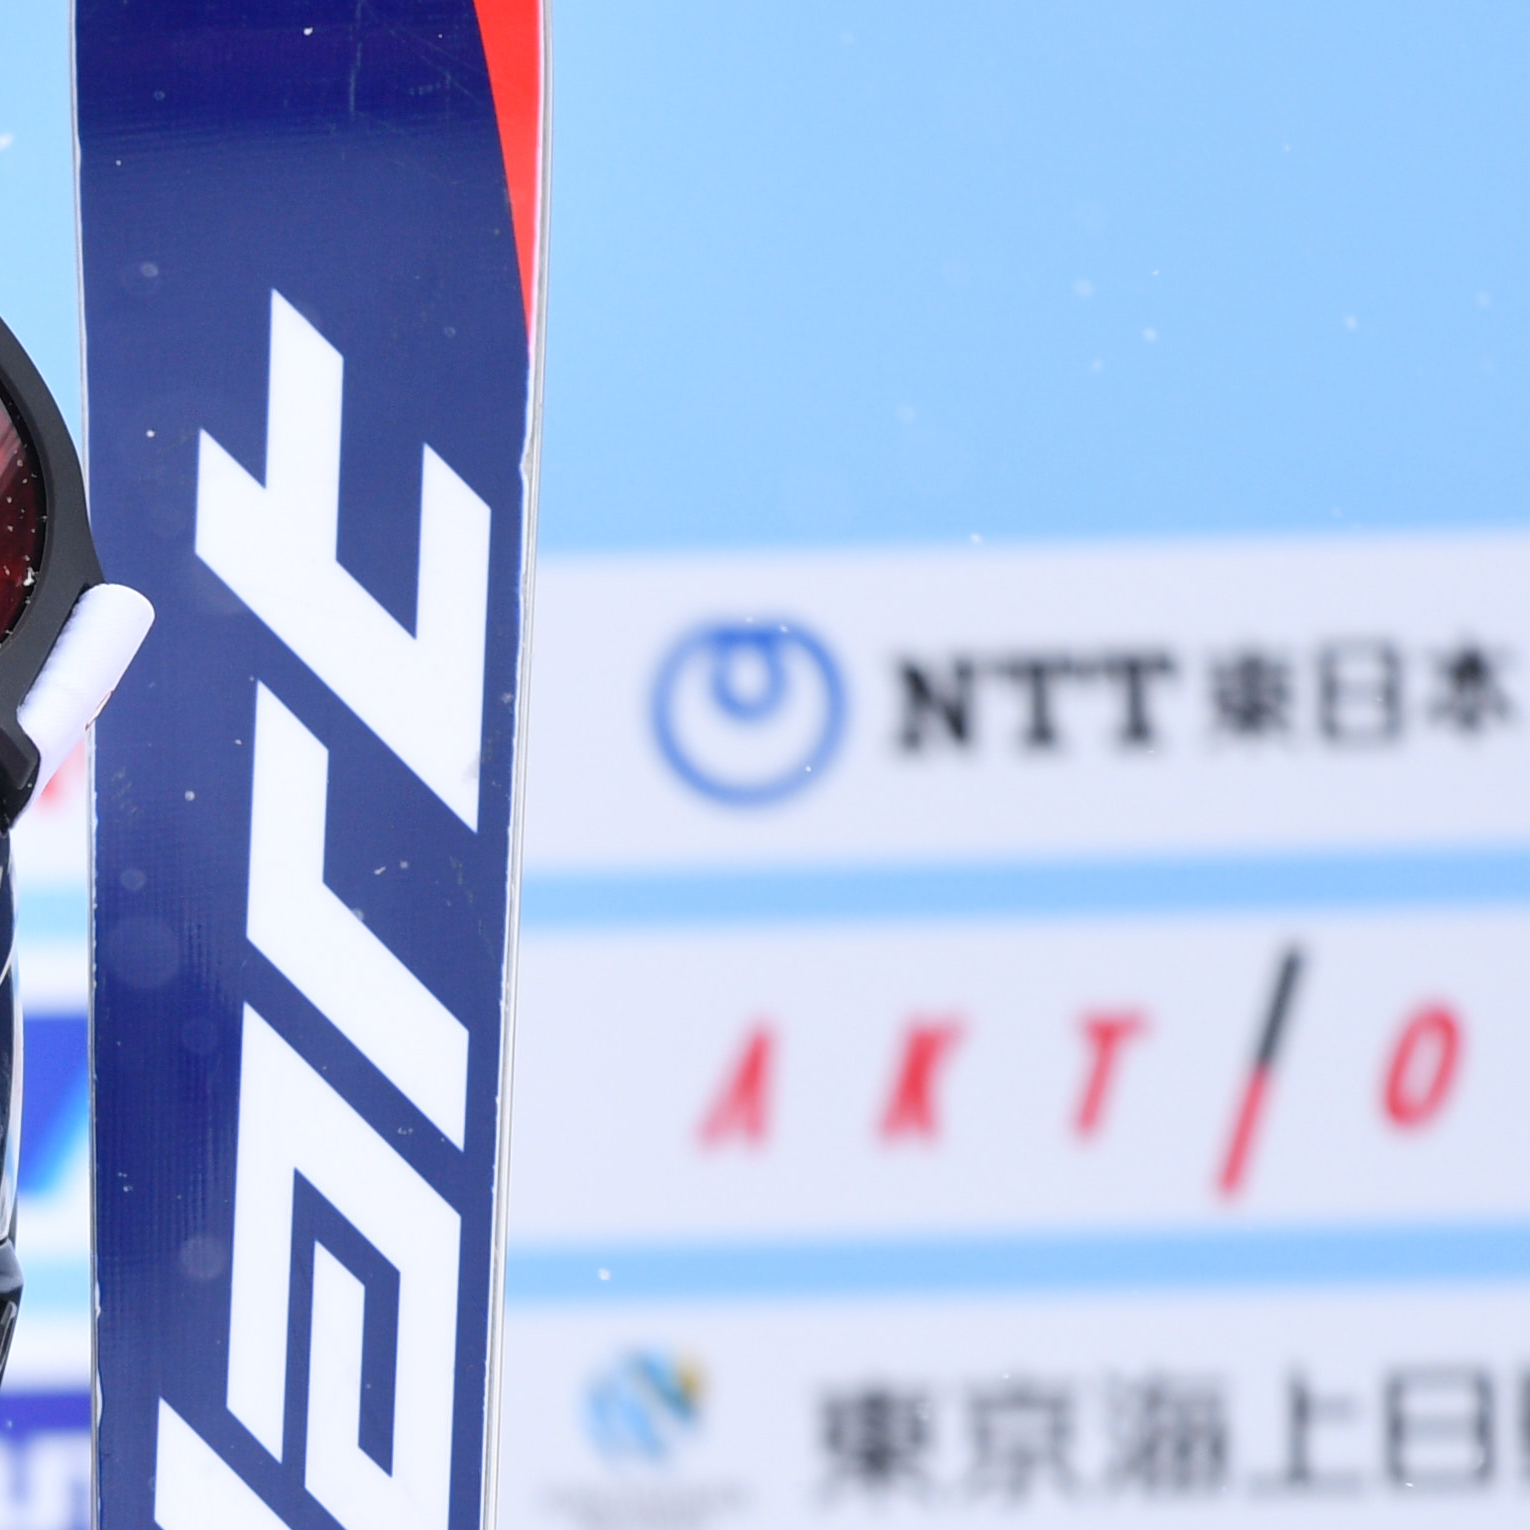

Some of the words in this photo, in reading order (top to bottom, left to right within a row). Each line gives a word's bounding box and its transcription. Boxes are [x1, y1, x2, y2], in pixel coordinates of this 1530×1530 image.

[813, 1360, 1530, 1504] 東京海上日
